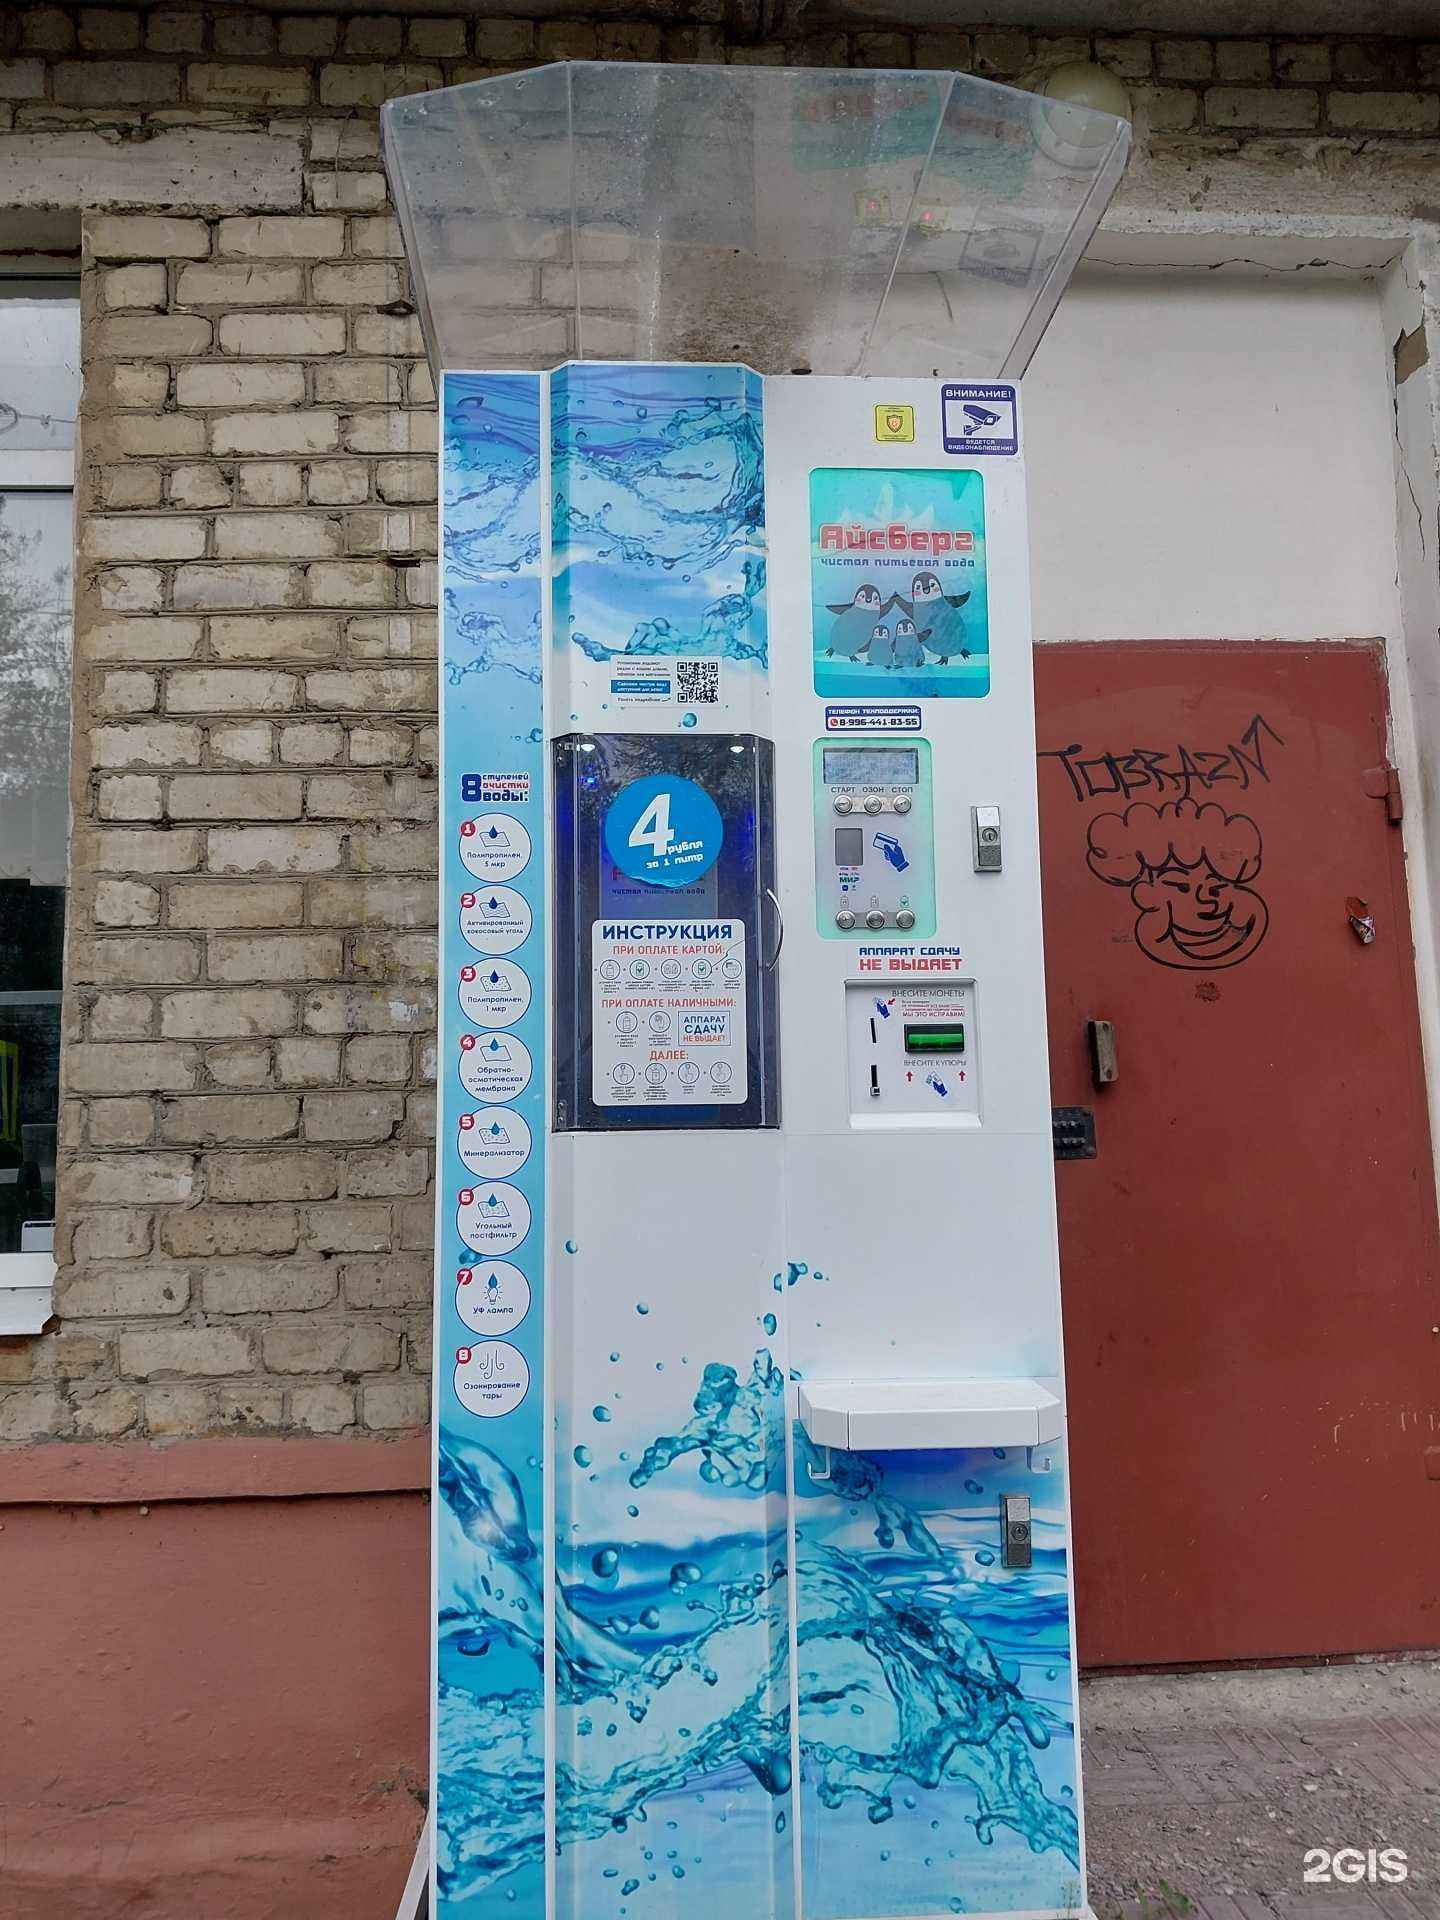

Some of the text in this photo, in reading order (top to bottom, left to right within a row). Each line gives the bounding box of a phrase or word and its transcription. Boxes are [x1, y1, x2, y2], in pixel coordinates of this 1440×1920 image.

[945, 389, 1011, 398] ВНИМАНИЕ!
[819, 523, 976, 556] Айсберг
[821, 558, 975, 568] чистая питьевая вода
[839, 718, 918, 726] 8-996-441-83-55
[482, 772, 529, 782] ступеней
[462, 773, 482, 802] 8
[482, 789, 528, 802] воды:
[464, 824, 472, 835] 1
[628, 793, 674, 857] 4
[666, 839, 703, 855] рубля
[646, 853, 704, 869] за 1 литр
[464, 896, 473, 906] 2
[602, 924, 733, 941] ИНСТРУКЦИЯ
[613, 943, 725, 955] ПРИ ОПЛАТЕ КАРТОЙ:
[859, 947, 960, 956] АППАРАТ СДАЧУ
[859, 958, 962, 971] НЕ ВЫДАЕТ
[464, 969, 473, 979] 3
[892, 989, 965, 998] ВНЕСИТЕ МОНЕТЫ
[601, 998, 736, 1008] ПРИ ОПЛАТЕ НАЛИЧНЫМИ:
[683, 1015, 726, 1024] АППАРАТ
[684, 1024, 725, 1034] СДАЧУ
[463, 1038, 472, 1048] 4
[683, 1034, 693, 1042] НЕ
[649, 1050, 689, 1062] ДАЛЕЕ:
[904, 1059, 967, 1067] ВНЕСИТЕ КУПЮРЫ
[477, 1066, 514, 1074] Обратно-
[462, 1116, 472, 1128] 5
[461, 1191, 471, 1203] 6
[475, 1222, 512, 1230] Угольный
[460, 1271, 470, 1282] 7
[460, 1350, 469, 1361] 8
[463, 1382, 521, 1390] Озонирование
